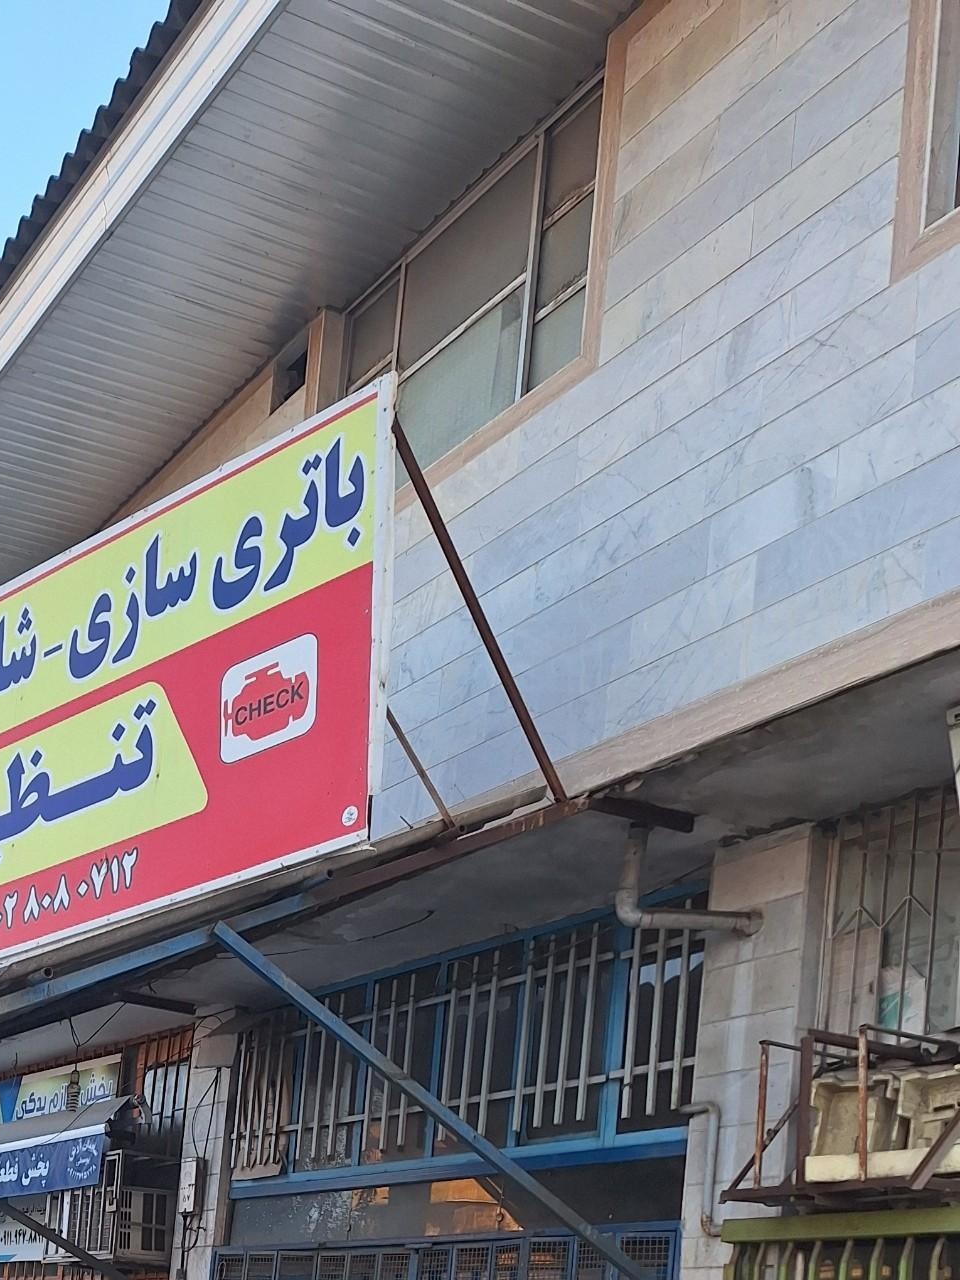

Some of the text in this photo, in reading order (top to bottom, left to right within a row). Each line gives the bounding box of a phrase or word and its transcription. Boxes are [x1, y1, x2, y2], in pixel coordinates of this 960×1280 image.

[212, 437, 365, 610] باتری
[234, 681, 304, 726] CHECK
[21, 1153, 50, 1188] پخش
